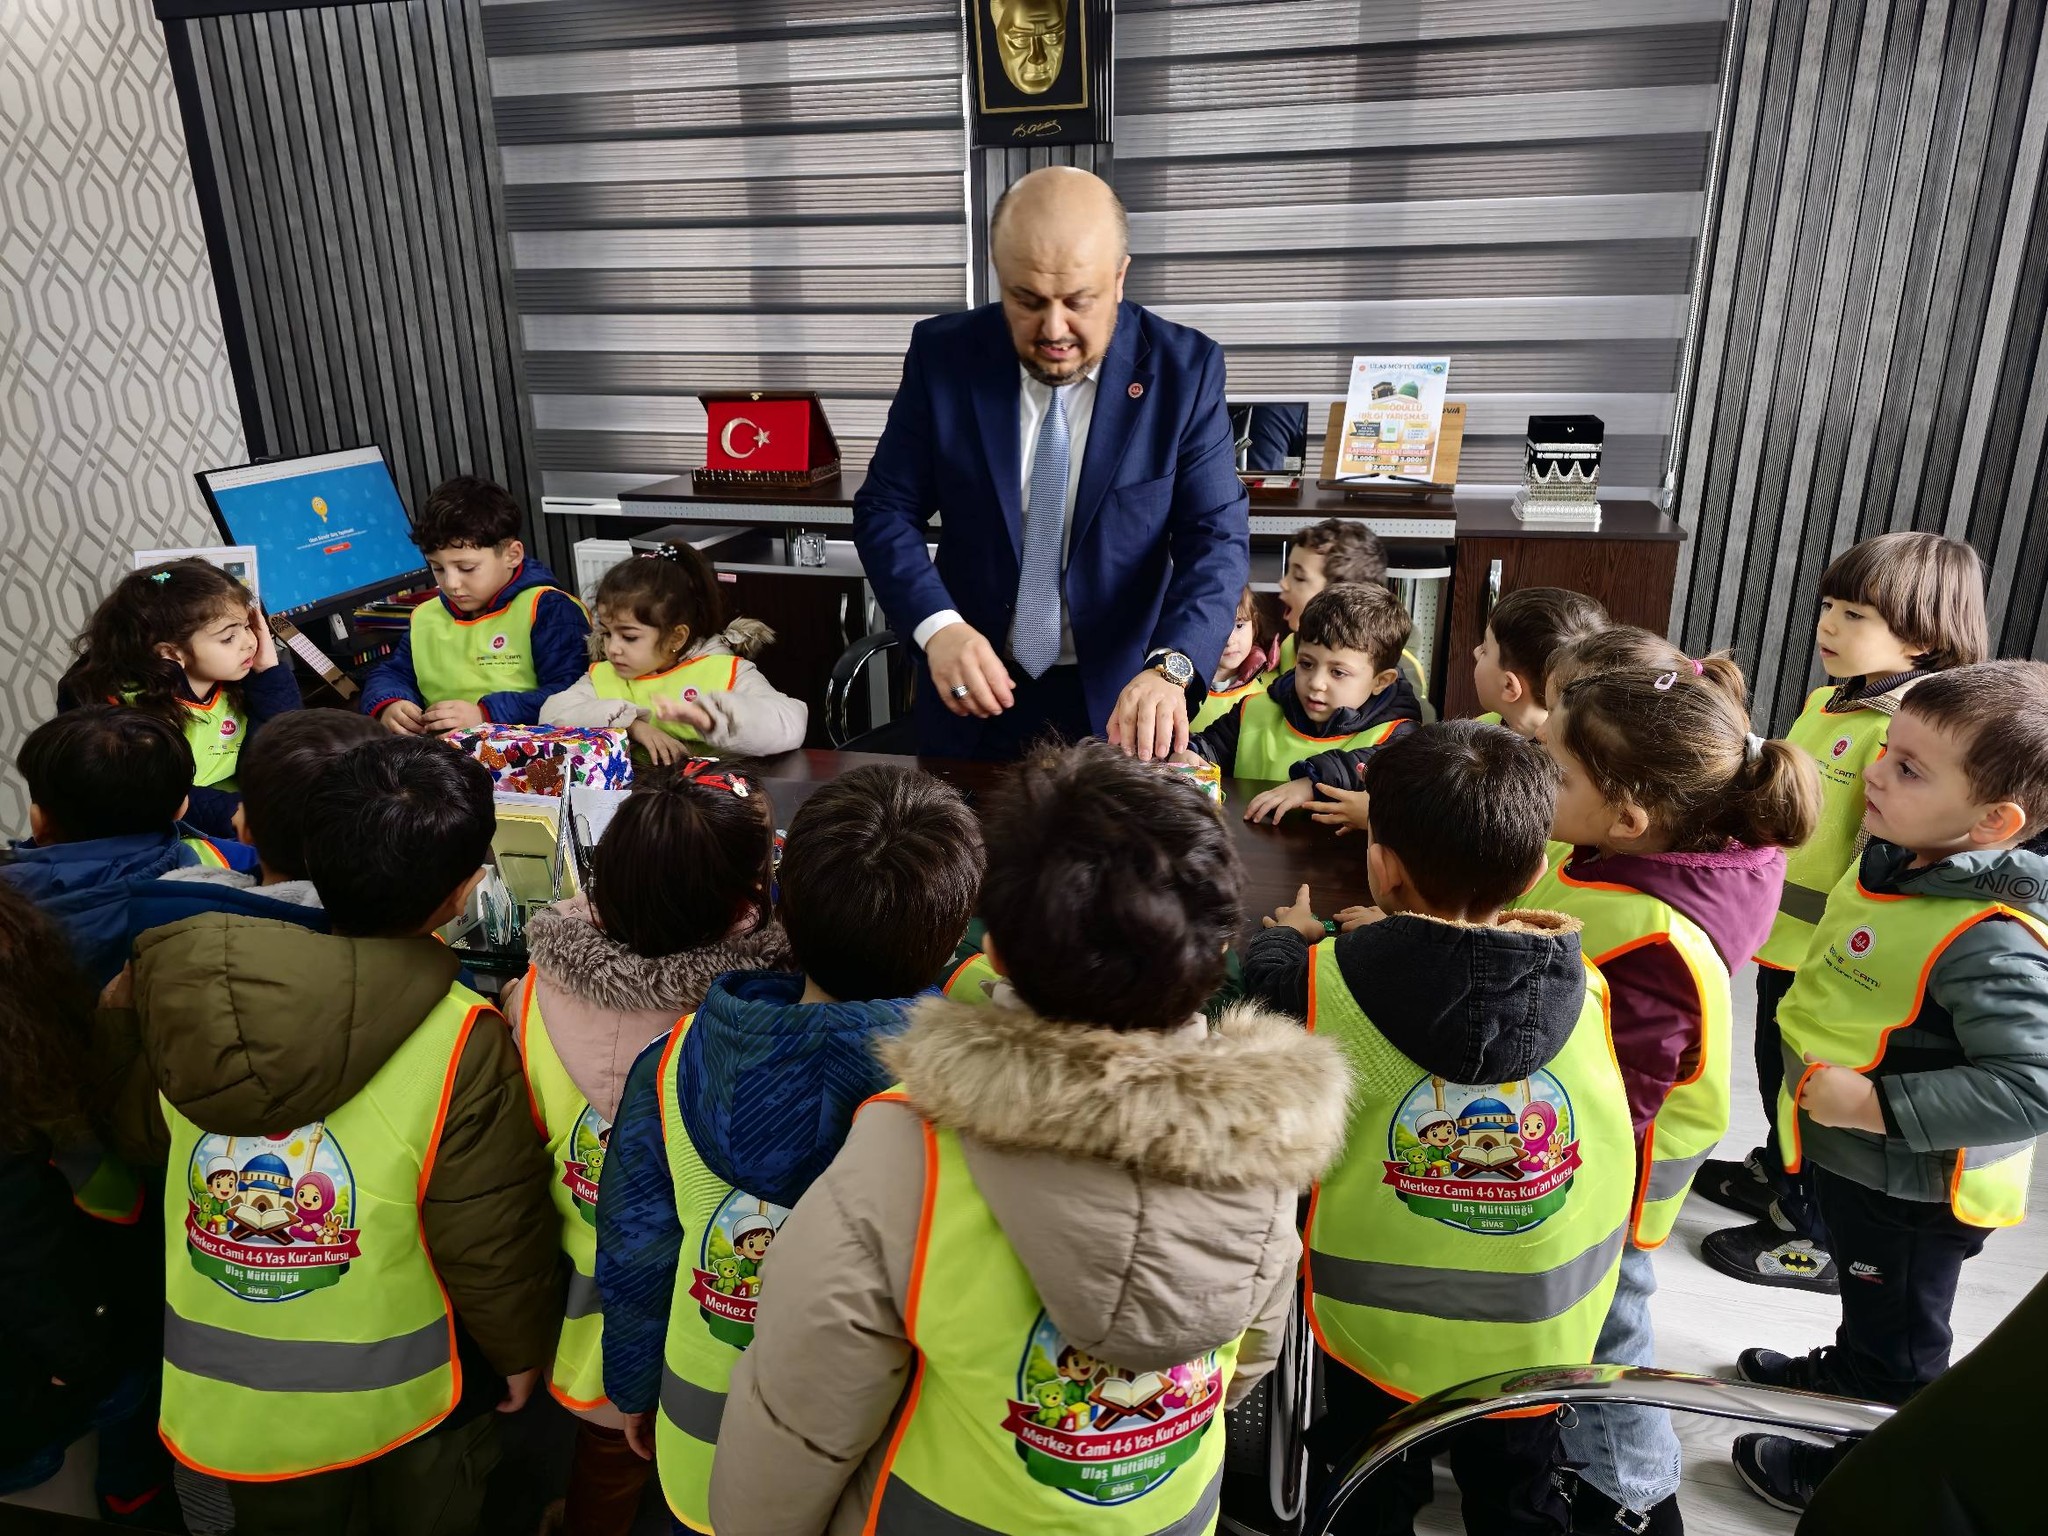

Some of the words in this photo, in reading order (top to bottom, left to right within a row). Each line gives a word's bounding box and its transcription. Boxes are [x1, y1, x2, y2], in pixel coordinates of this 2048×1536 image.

[1430, 1169, 1438, 1178] 4
[1442, 1165, 1449, 1175] 6
[1400, 1178, 1440, 1195] Merkez
[1443, 1184, 1473, 1197] Cami
[1477, 1186, 1494, 1197] 4-6
[1496, 1186, 1517, 1200] Yaş
[1519, 1179, 1550, 1196] Kur'an
[1551, 1166, 1573, 1186] Kursu
[576, 1182, 599, 1201] Merk
[1452, 1204, 1475, 1215] Ulaş
[1479, 1204, 1533, 1216] Müftülüğü
[210, 1226, 216, 1234] 4
[1481, 1219, 1504, 1228] SİVAS
[190, 1226, 217, 1253] Merkez
[219, 1243, 244, 1261] Cami
[246, 1251, 263, 1264] 4-6
[265, 1252, 285, 1267] Yaş
[288, 1252, 322, 1264] Kur'an
[324, 1251, 349, 1262] Kursu
[1852, 1260, 1878, 1272] NIKE
[225, 1265, 243, 1280] Ulaş
[247, 1270, 299, 1284] Müftülüğü
[247, 1286, 268, 1296] SİVAS
[739, 1286, 746, 1297] 4
[752, 1283, 759, 1294] 6
[705, 1294, 746, 1318] Merkez
[1065, 1417, 1074, 1431] 4
[1078, 1411, 1088, 1425] 6
[1022, 1427, 1073, 1455] Merkez
[1076, 1440, 1111, 1457] Cami
[1113, 1439, 1132, 1454] 4-6
[1134, 1434, 1154, 1450] Yaş
[1155, 1421, 1189, 1443] Kur'an
[1190, 1403, 1216, 1427] Kursu
[1081, 1467, 1109, 1482] Ulaş
[1112, 1453, 1167, 1477] Müftülüğü
[1110, 1482, 1135, 1496] SİVAS
